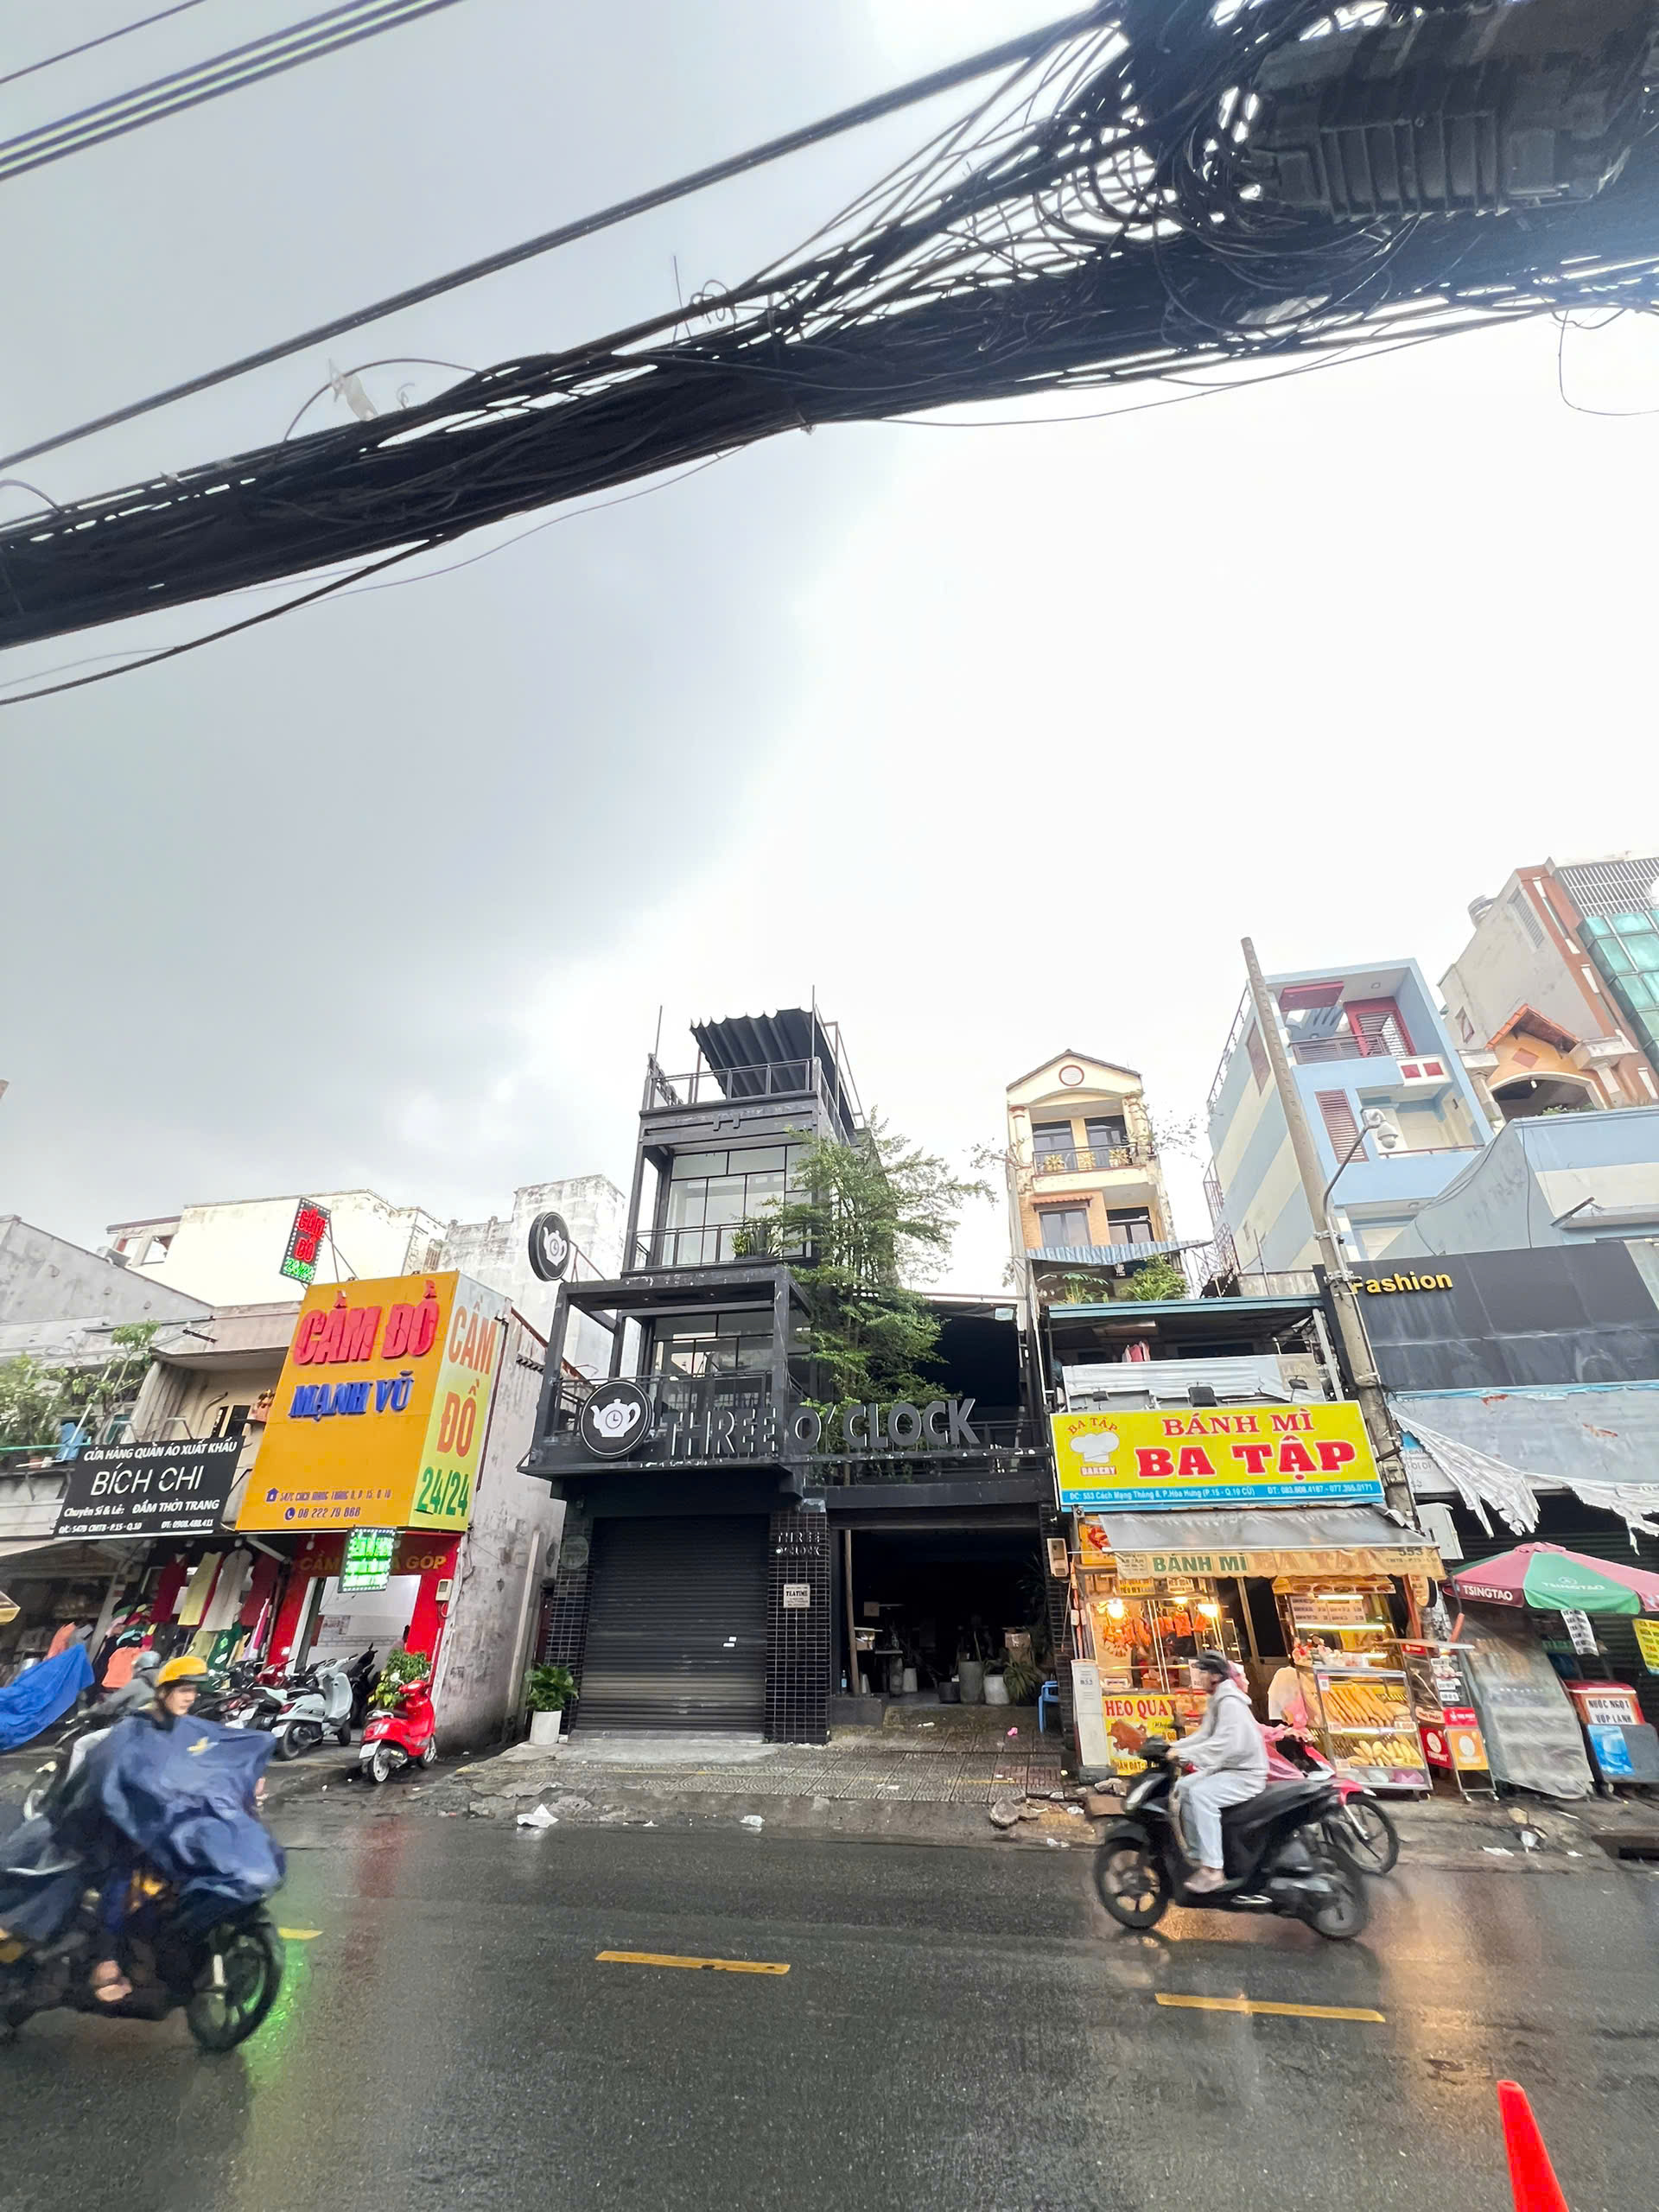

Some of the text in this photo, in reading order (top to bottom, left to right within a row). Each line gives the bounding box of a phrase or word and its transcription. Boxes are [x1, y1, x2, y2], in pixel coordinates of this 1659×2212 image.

[1351, 1271, 1453, 1294] Fashion
[293, 1280, 442, 1365] CẦM ĐỒ
[448, 1300, 499, 1376] CẦM
[288, 1370, 415, 1422] MẠNH VŨ
[436, 1379, 480, 1458] ĐỒ
[662, 1408, 779, 1457] THREE
[1068, 1420, 1085, 1434] BA
[1163, 1408, 1315, 1436] BÁNH MÌ
[165, 1442, 181, 1457] ÁO
[181, 1440, 209, 1454] XUẤT
[1135, 1434, 1356, 1481] BA TẬP
[91, 1463, 204, 1496] BÍCH CHI
[416, 1466, 470, 1517] 24/24
[185, 1499, 220, 1511] TRANG
[405, 1551, 447, 1570] GÓP
[1462, 1585, 1513, 1601] TSINGTAO
[1104, 1700, 1134, 1716] HEO
